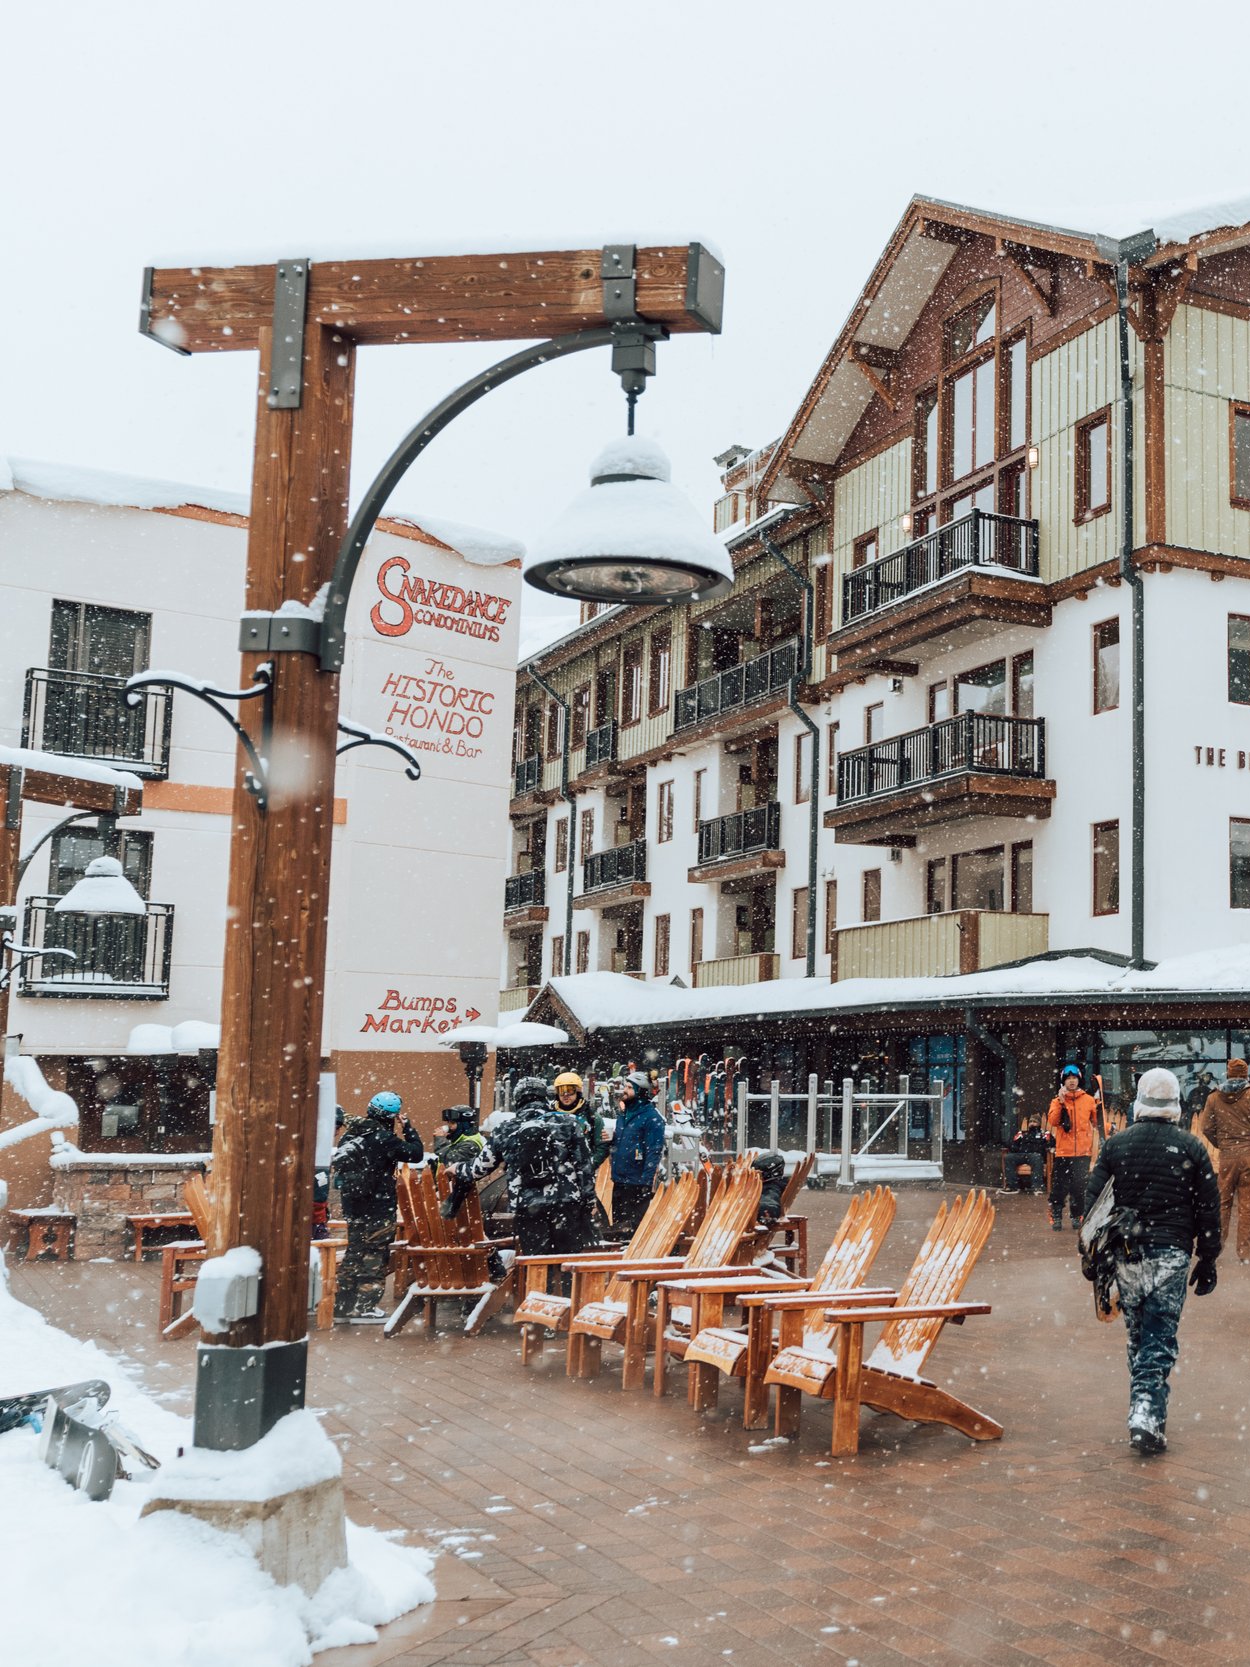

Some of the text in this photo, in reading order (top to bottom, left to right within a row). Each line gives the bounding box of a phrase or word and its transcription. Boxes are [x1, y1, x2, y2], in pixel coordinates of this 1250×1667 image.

[370, 556, 512, 637] SNAKEDANCE
[414, 608, 500, 643] CONDOMINIUMS
[425, 658, 455, 680] The
[381, 672, 495, 715] HISTORIC
[387, 701, 484, 738] HONDO
[442, 738, 454, 755] &
[456, 739, 482, 758] Bar
[1194, 745, 1226, 768] THE
[377, 989, 457, 1018] Bumps
[360, 1013, 462, 1034] Market
